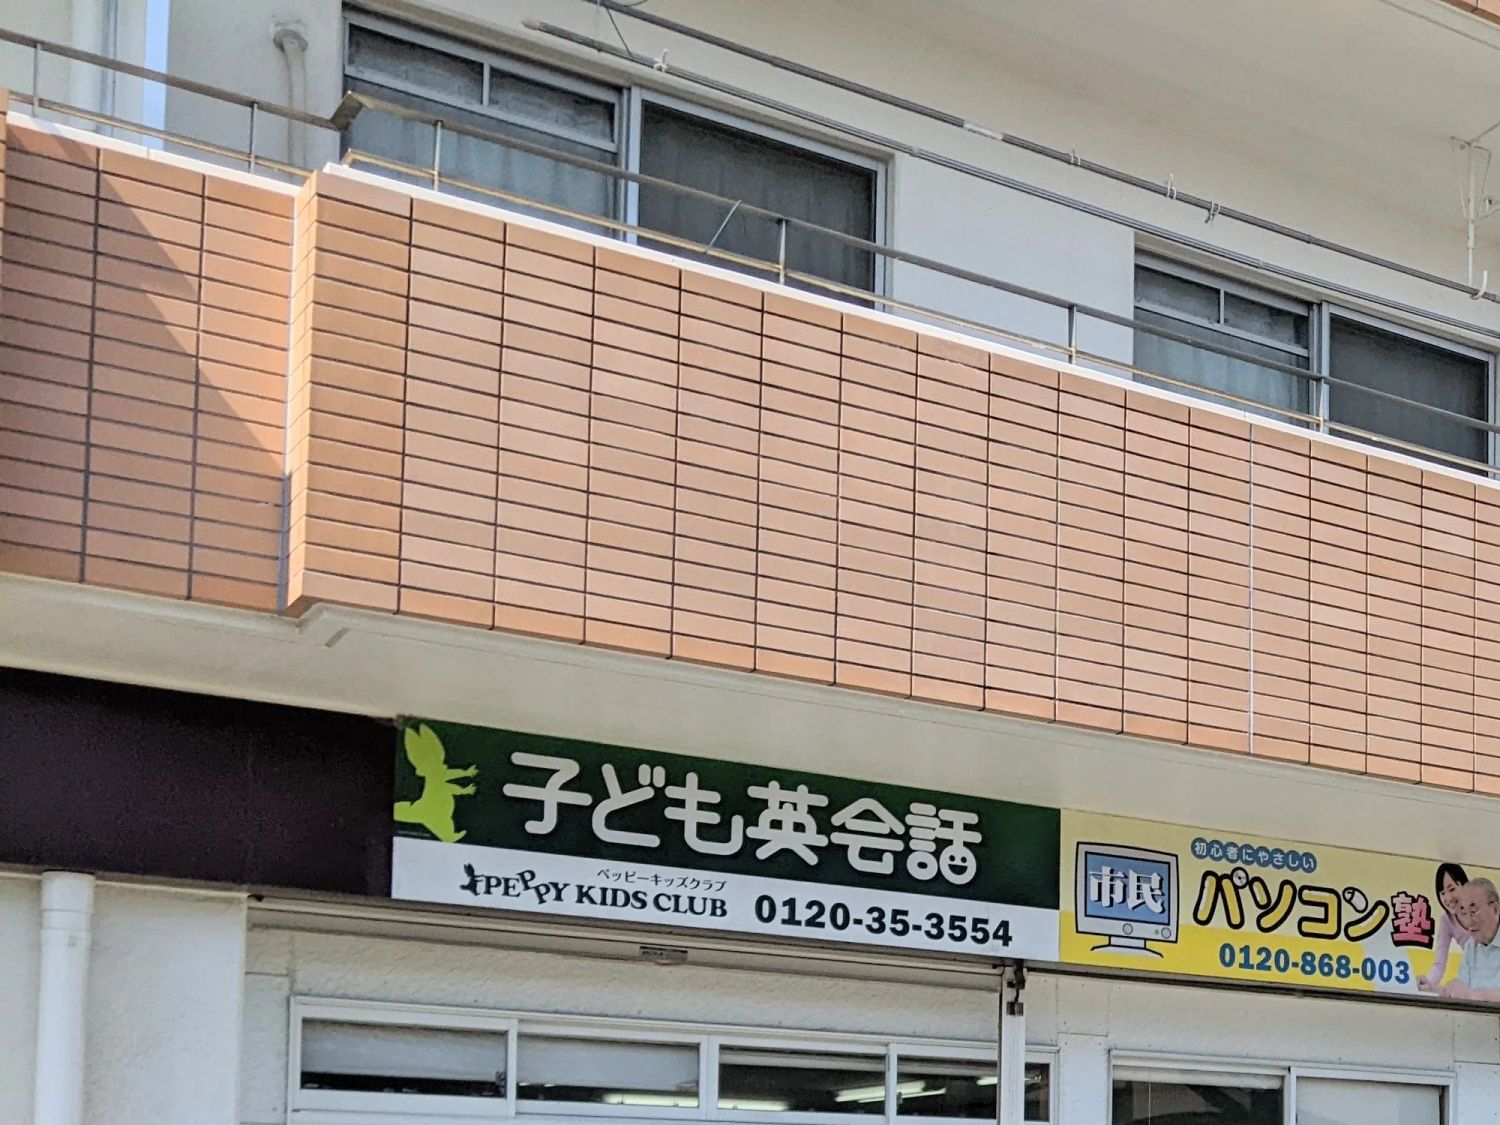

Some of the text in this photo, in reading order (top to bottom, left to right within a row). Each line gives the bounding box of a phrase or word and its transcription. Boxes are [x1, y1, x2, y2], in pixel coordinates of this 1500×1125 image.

[502, 751, 984, 886] 子ども英会話
[1192, 838, 1318, 873] 初心者にやさしい
[483, 869, 728, 918] PEPPY KIDS CLUB
[597, 869, 727, 893] ペッピーキッズクラブ
[1088, 867, 1167, 914] 市民
[753, 893, 1014, 948] 0120-35-3554
[1192, 867, 1436, 949] パソコン塾
[1219, 943, 1411, 986] 0120-868-003
